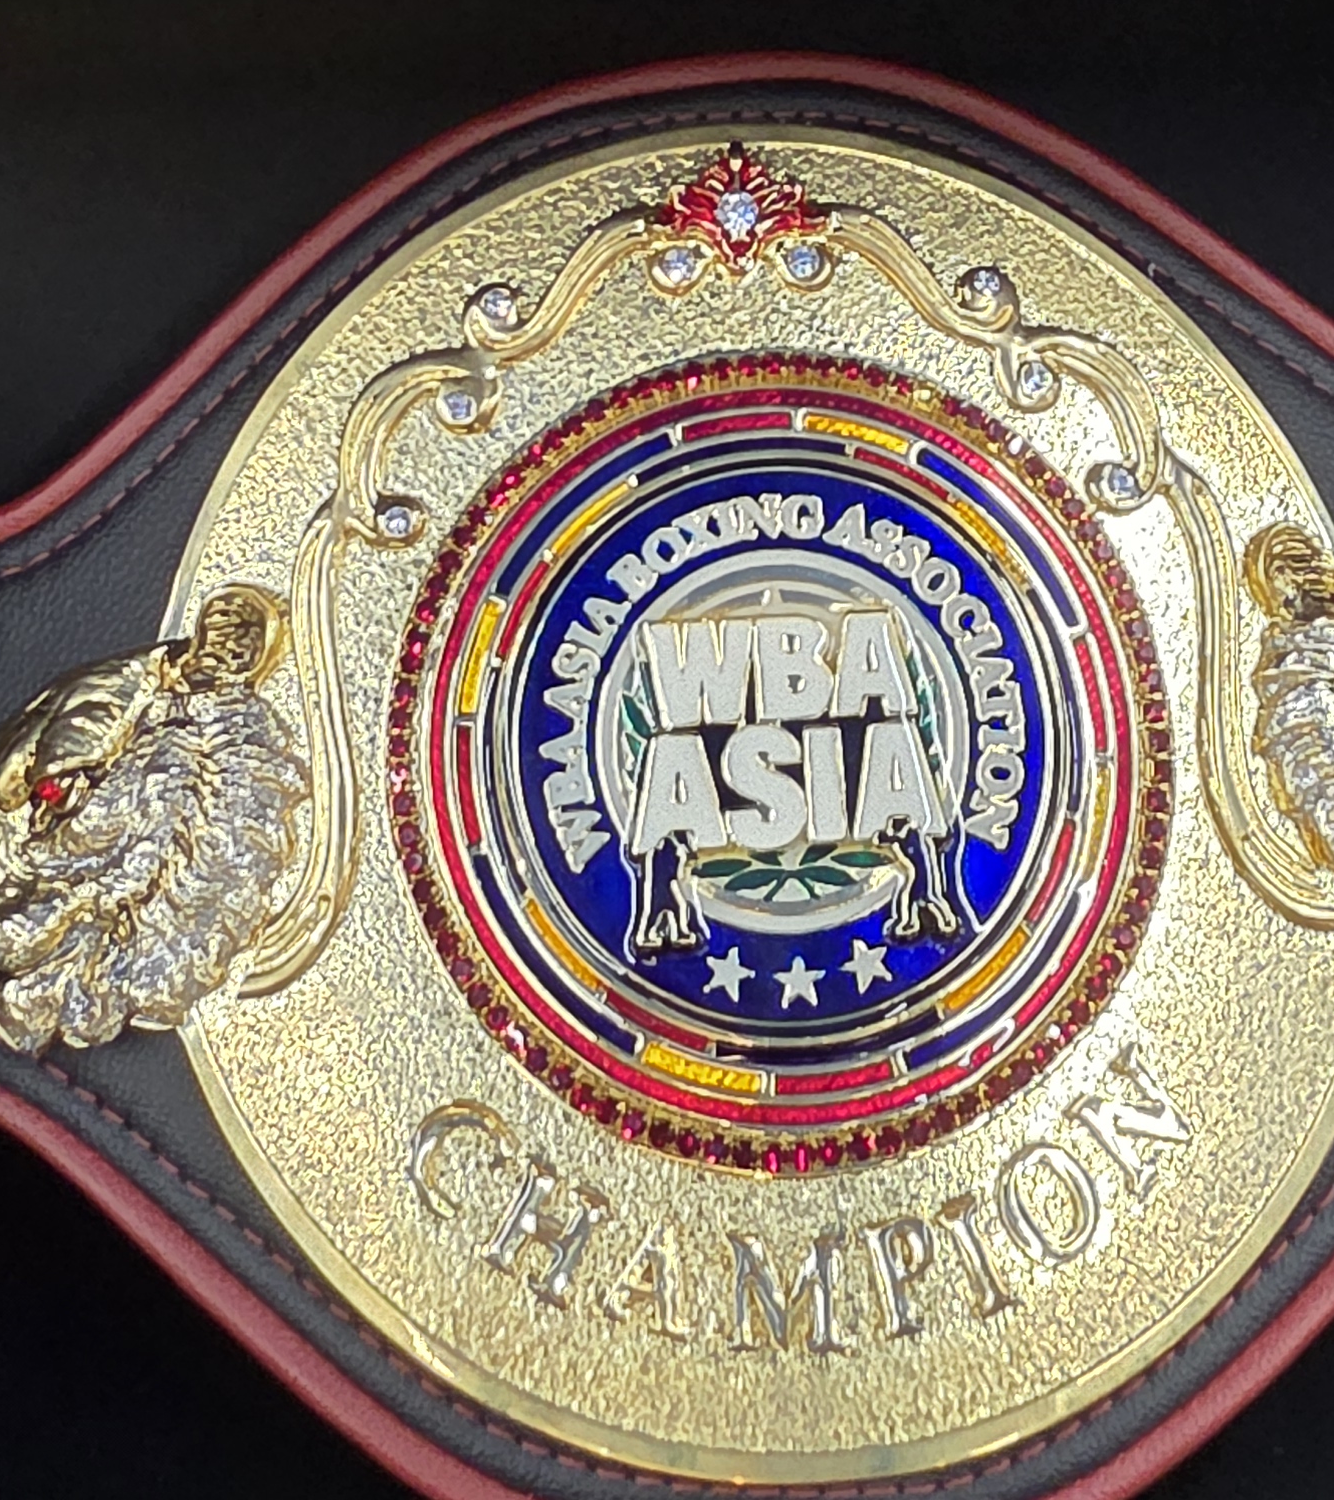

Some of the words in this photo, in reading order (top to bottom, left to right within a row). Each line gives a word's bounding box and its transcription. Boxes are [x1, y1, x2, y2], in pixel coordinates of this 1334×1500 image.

[606, 493, 826, 604] BOXING
[543, 597, 632, 722] ASIA
[639, 610, 919, 727] WBA
[823, 503, 1027, 852] ASSOCIATION
[539, 722, 611, 874] WBA
[630, 719, 955, 855] ASIA
[408, 1041, 1201, 1358] CHAMPION
